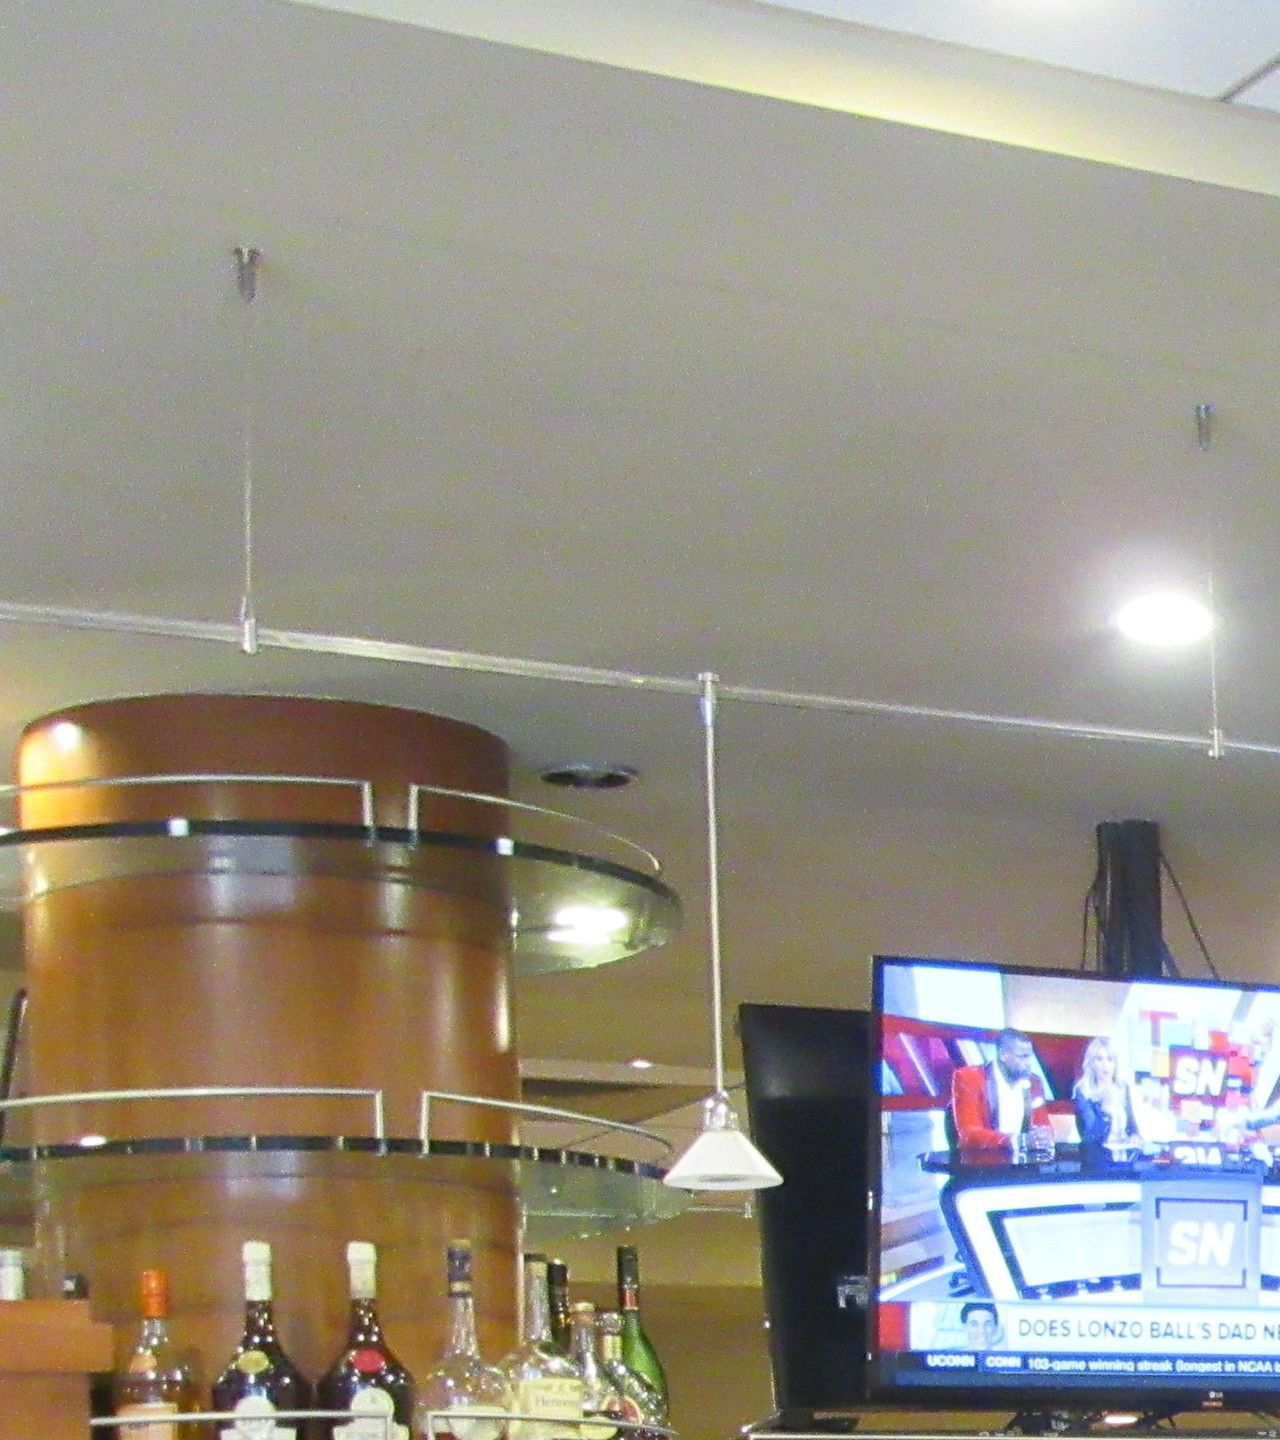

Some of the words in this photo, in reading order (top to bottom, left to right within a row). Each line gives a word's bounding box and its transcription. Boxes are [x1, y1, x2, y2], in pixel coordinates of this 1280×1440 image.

[1174, 1056, 1228, 1097] SN
[1167, 1221, 1237, 1266] SN
[1019, 1319, 1071, 1338] DOES
[1078, 1319, 1144, 1339] LONZO
[1150, 1319, 1212, 1341] BALL'S
[1217, 1322, 1257, 1341] DAD
[926, 1353, 976, 1369] UCONN
[984, 1355, 1022, 1369] CONN
[1028, 1357, 1087, 1372] 103-game
[1088, 1359, 1135, 1374] winning
[1137, 1358, 1173, 1373] streak
[1225, 1360, 1236, 1374] in
[1238, 1360, 1273, 1374] NCAA
